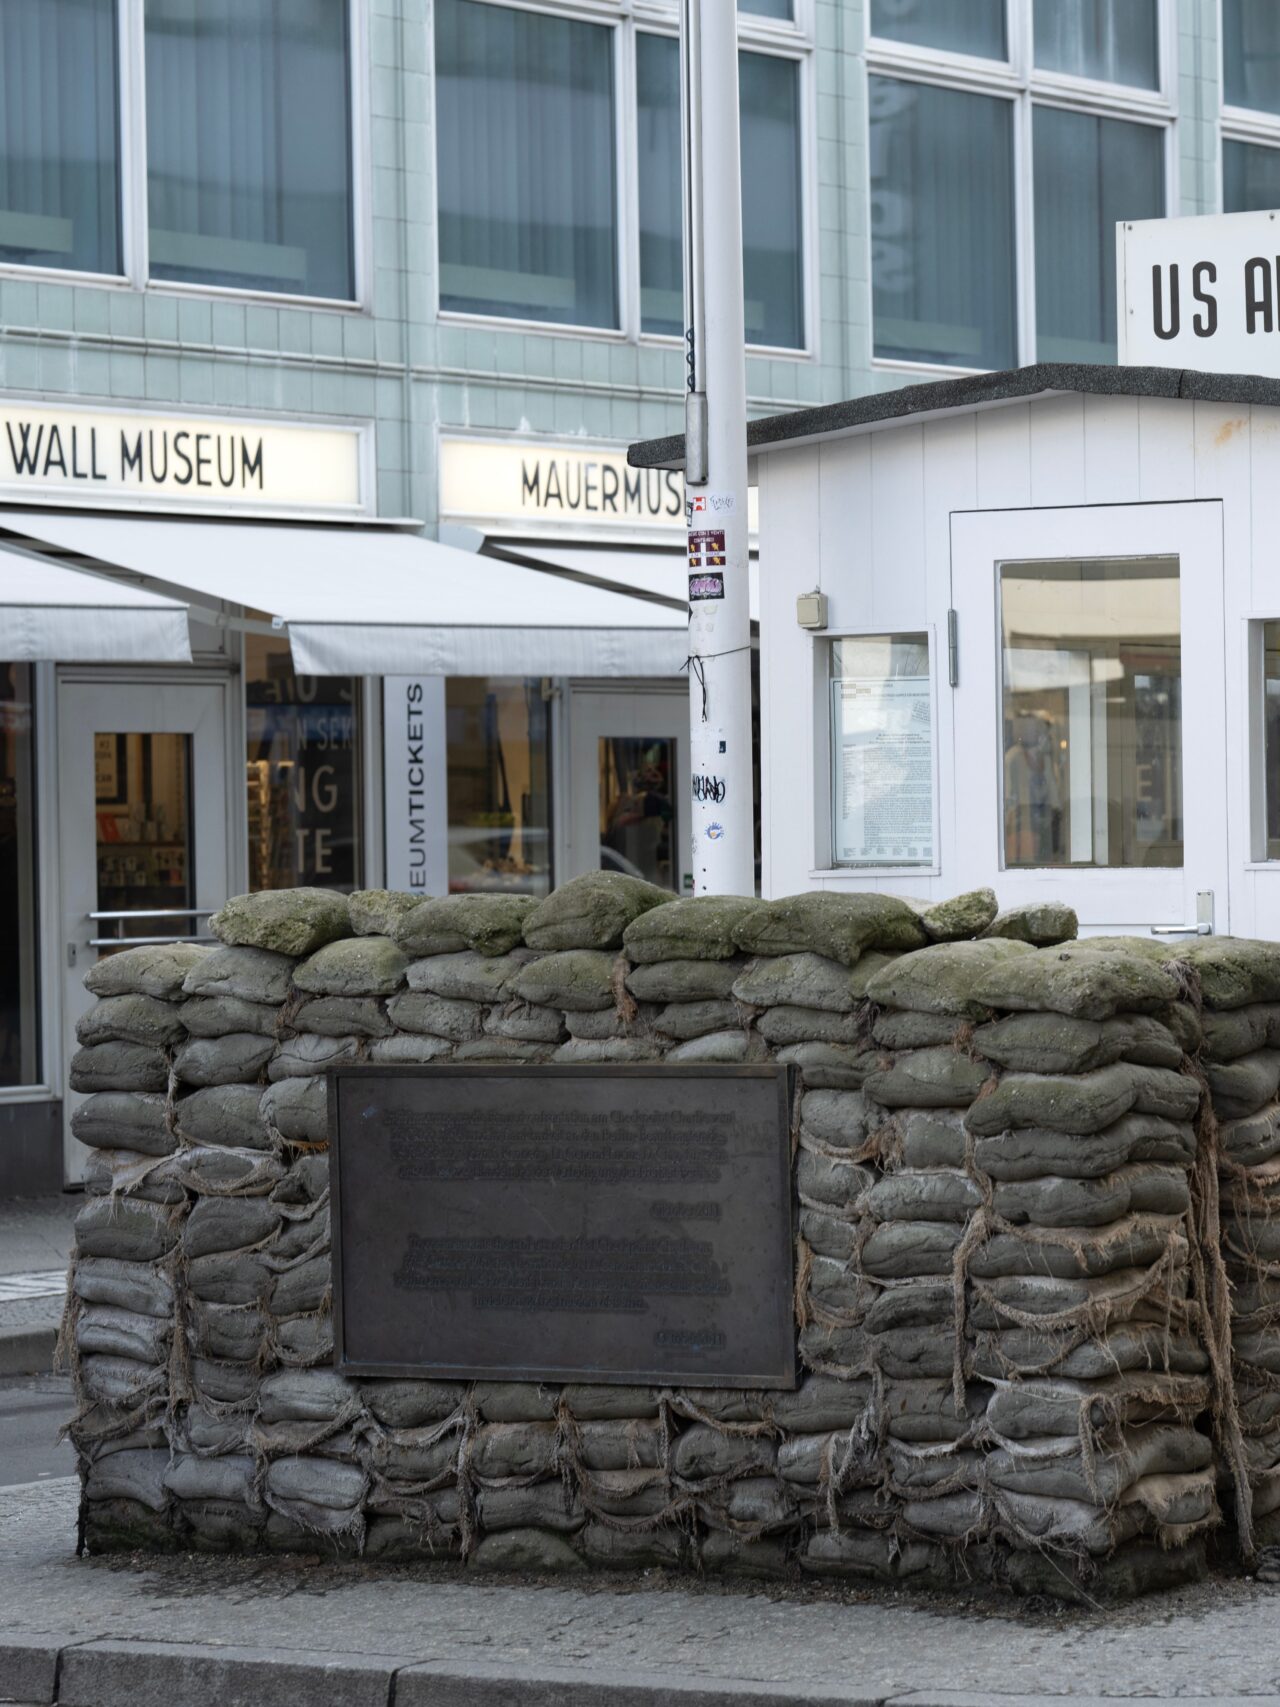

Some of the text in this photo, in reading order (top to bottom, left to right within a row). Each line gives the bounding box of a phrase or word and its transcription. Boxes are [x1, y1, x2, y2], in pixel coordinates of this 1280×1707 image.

[6, 421, 263, 490] WALL MUSEUM
[522, 459, 686, 516] MAUERMUS
[407, 683, 426, 894] EUMTICKETS
